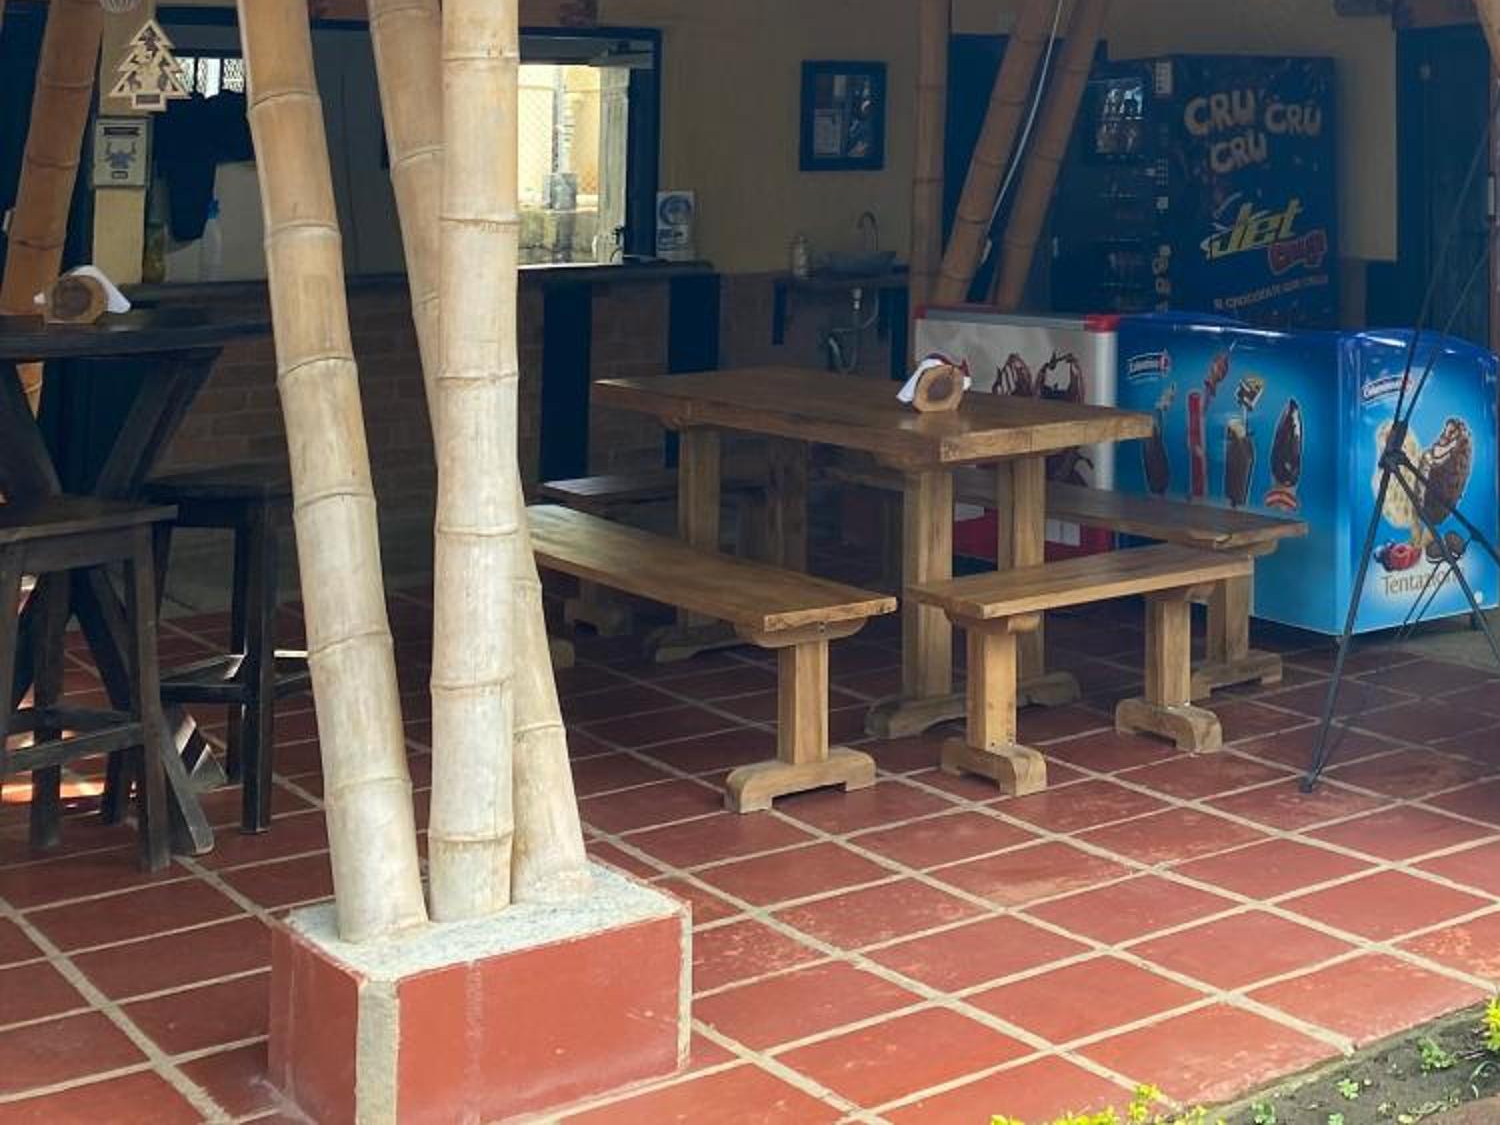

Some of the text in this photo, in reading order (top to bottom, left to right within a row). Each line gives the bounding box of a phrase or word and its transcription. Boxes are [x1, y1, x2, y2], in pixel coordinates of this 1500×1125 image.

[1184, 88, 1321, 136] CRU CRU
[1210, 129, 1267, 173] CRU
